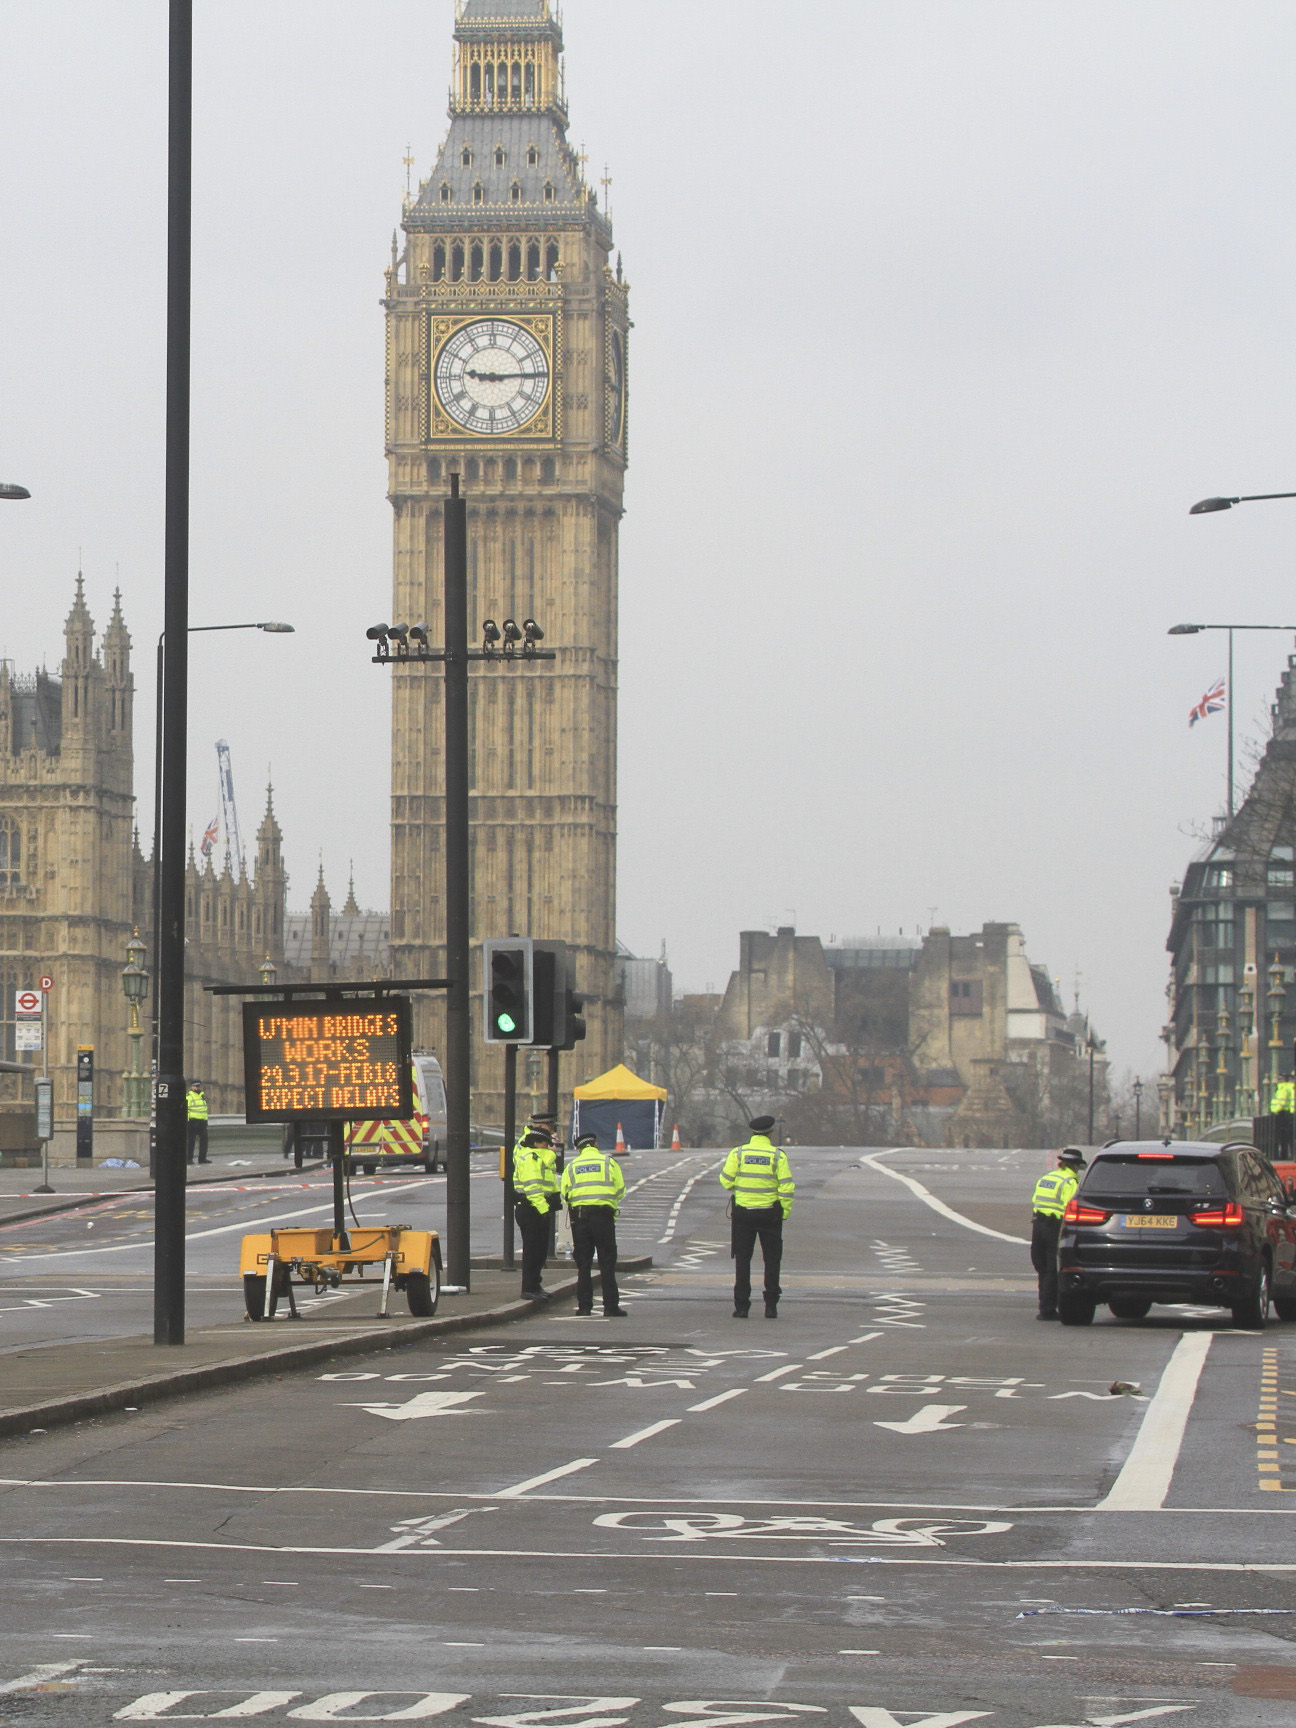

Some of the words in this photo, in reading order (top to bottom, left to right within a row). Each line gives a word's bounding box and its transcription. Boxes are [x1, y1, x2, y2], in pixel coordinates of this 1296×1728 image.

[42, 977, 52, 988] D
[324, 1014, 398, 1037] BRIDGES
[284, 1038, 370, 1062] WORKS
[260, 1061, 397, 1087] 29.3.17-FEB18
[160, 1085, 167, 1096] 7
[262, 1087, 326, 1110] EXPECT
[331, 1084, 400, 1108] DELAYS
[576, 1164, 601, 1174] POLICE
[1128, 1216, 1153, 1226] YJ64
[1155, 1216, 1176, 1226] KKE
